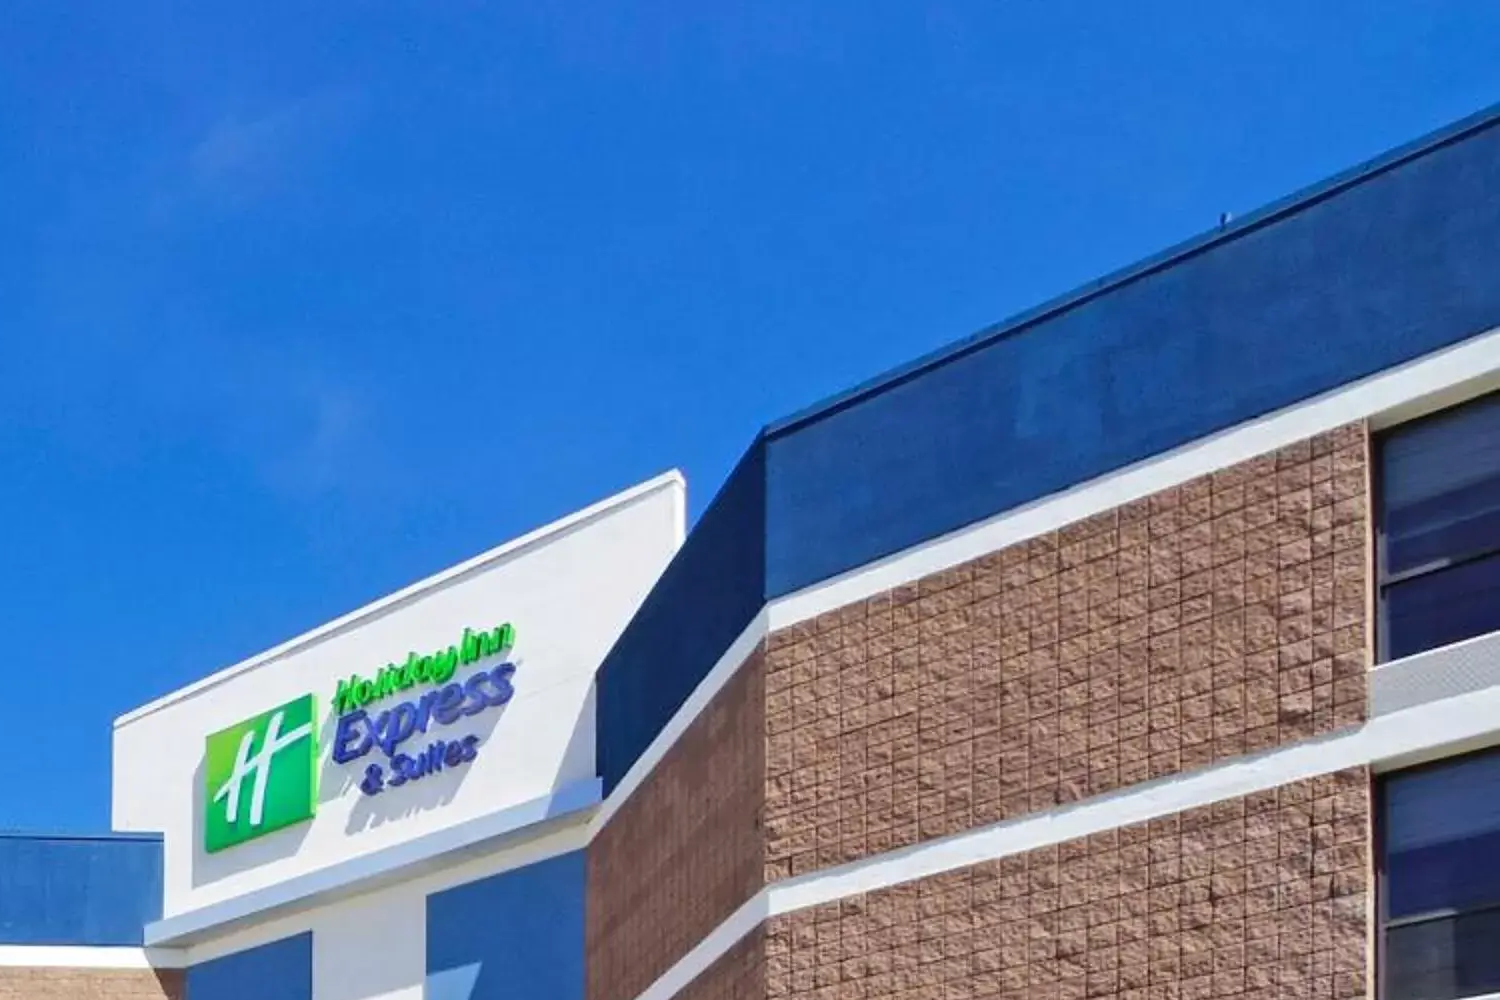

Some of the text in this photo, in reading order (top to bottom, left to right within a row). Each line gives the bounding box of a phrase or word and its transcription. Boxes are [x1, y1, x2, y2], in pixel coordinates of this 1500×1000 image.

[332, 623, 516, 716] Holiday Inn
[332, 662, 516, 764] Express
[360, 734, 481, 796] & Suites
